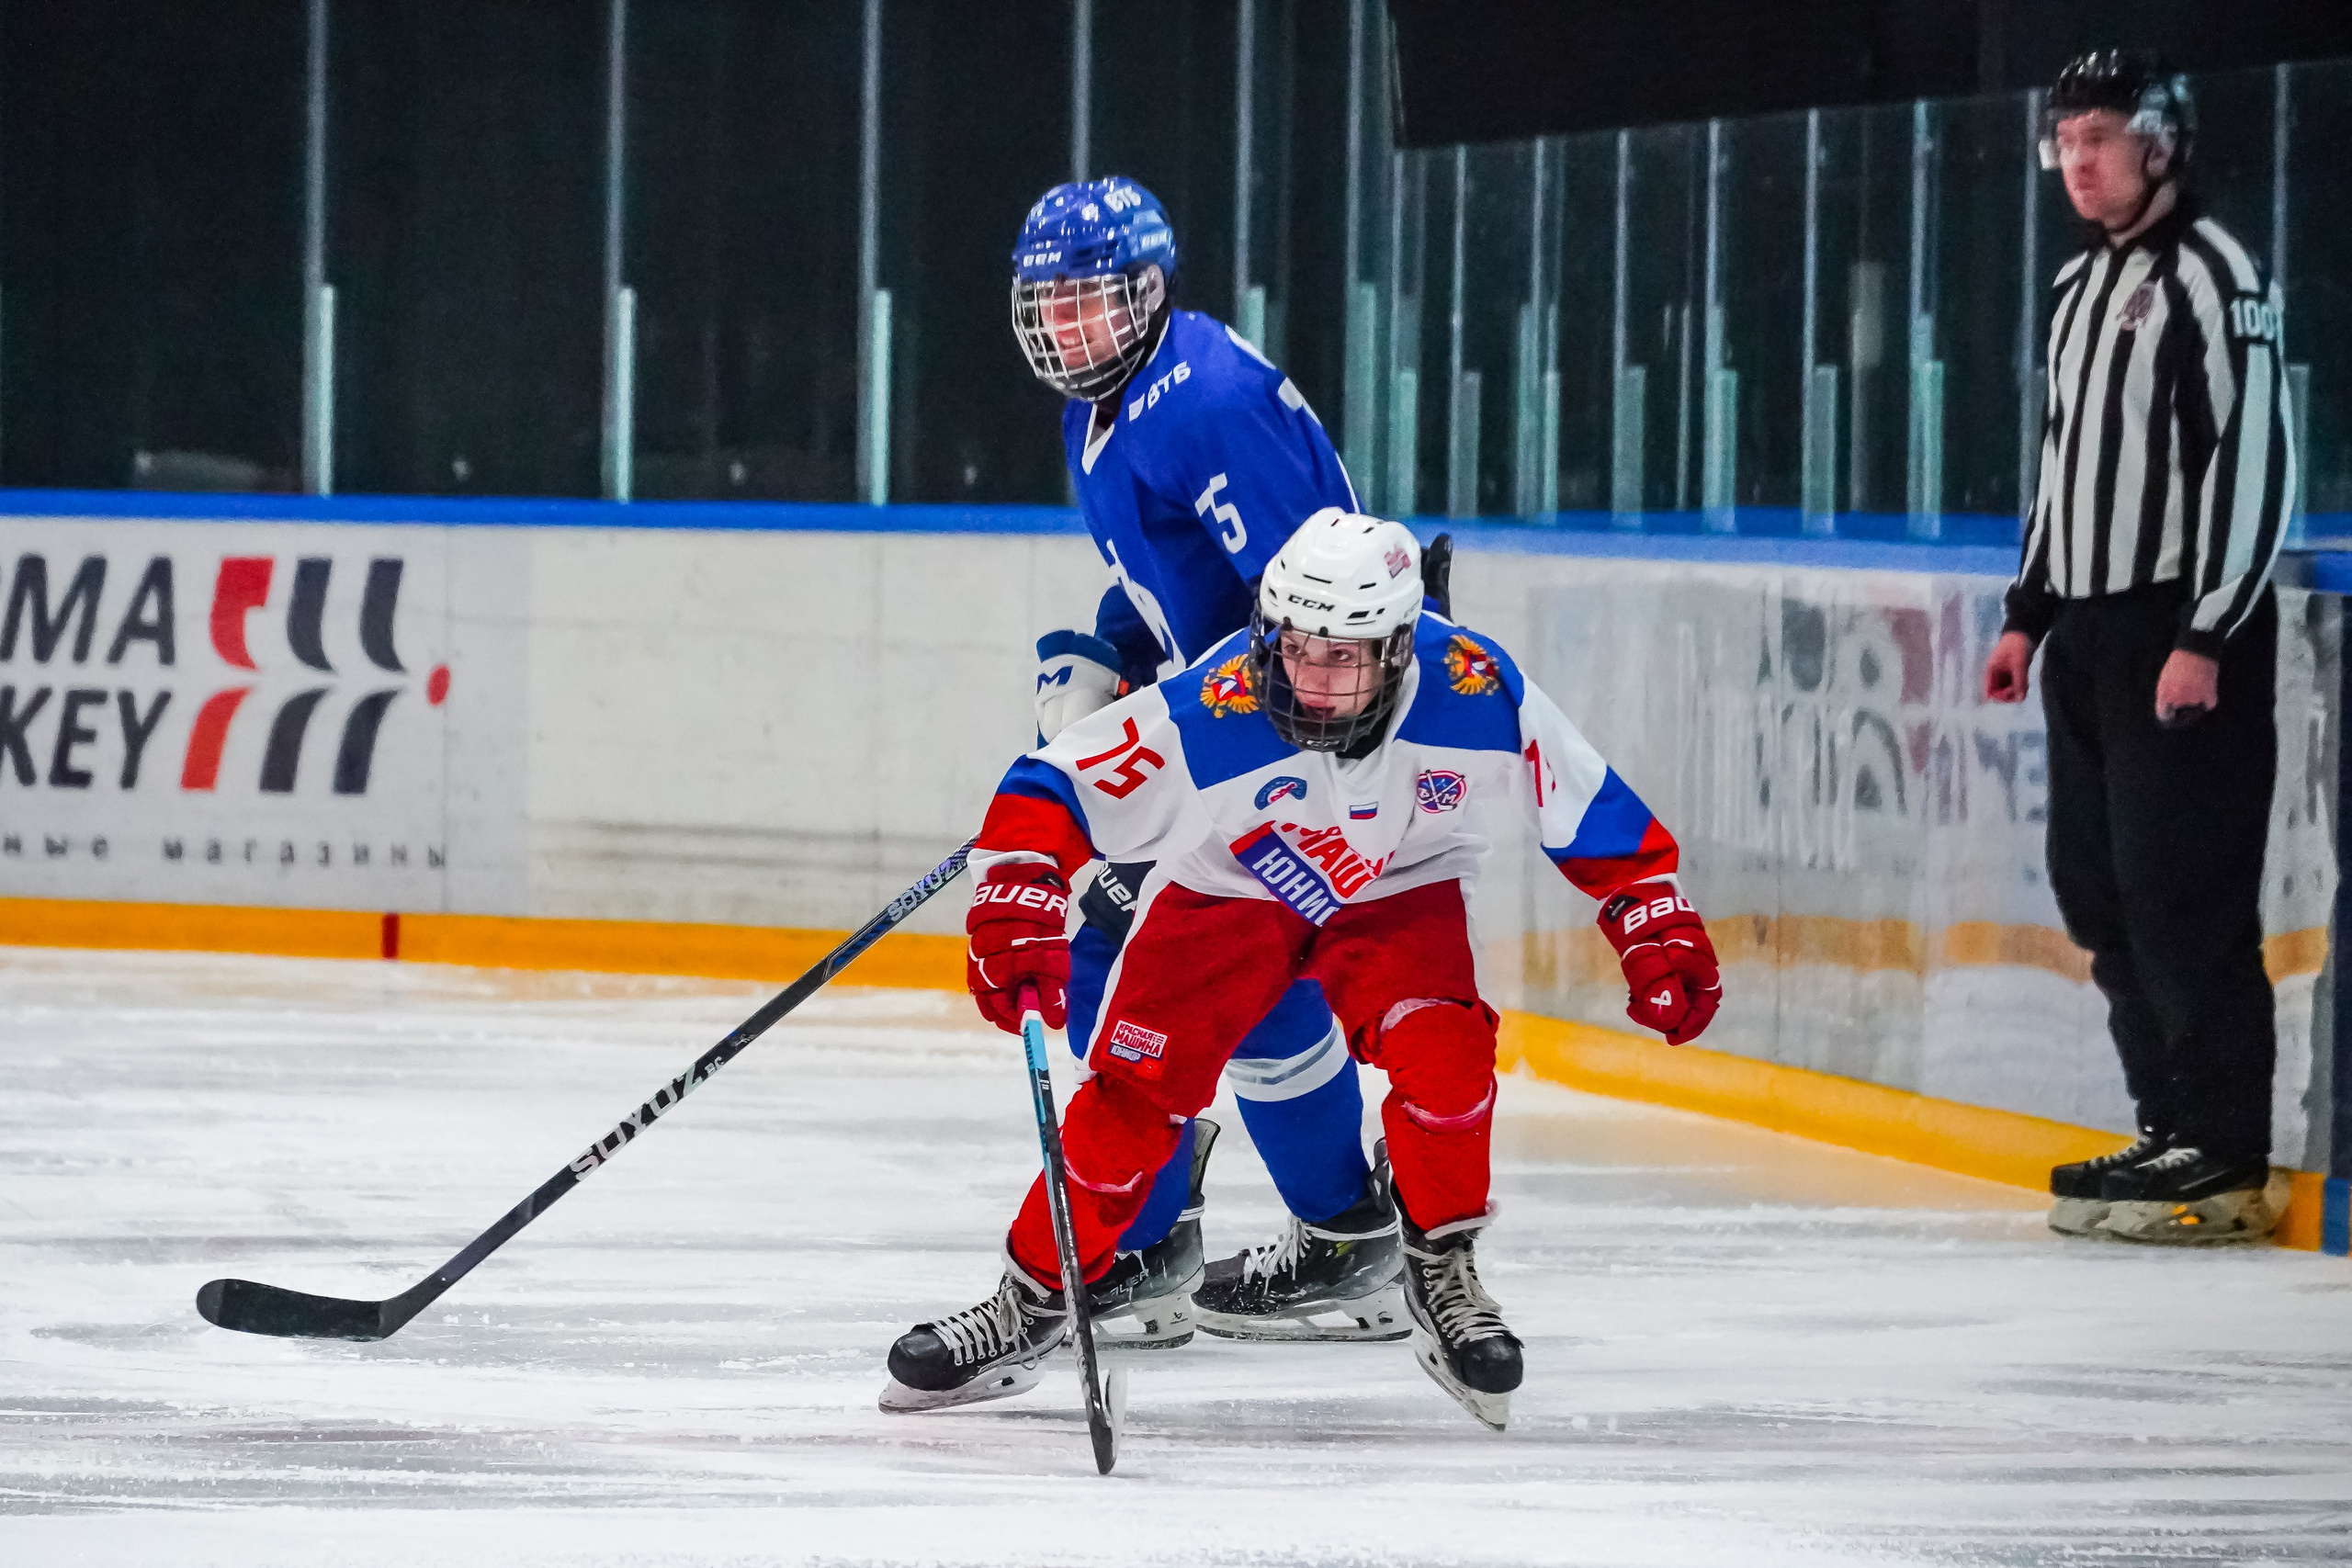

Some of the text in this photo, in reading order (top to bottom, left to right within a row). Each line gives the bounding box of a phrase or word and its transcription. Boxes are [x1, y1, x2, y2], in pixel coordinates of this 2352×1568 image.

[1148, 360, 1192, 411] ВТБ
[0, 553, 175, 666] MA
[1287, 593, 1335, 612] CCM
[0, 686, 172, 789] KEY
[1075, 716, 1165, 799] 75
[887, 860, 957, 921] SOYUZ
[1113, 1029, 1161, 1056] МАШИНА
[569, 1061, 704, 1181] SOYUZ
